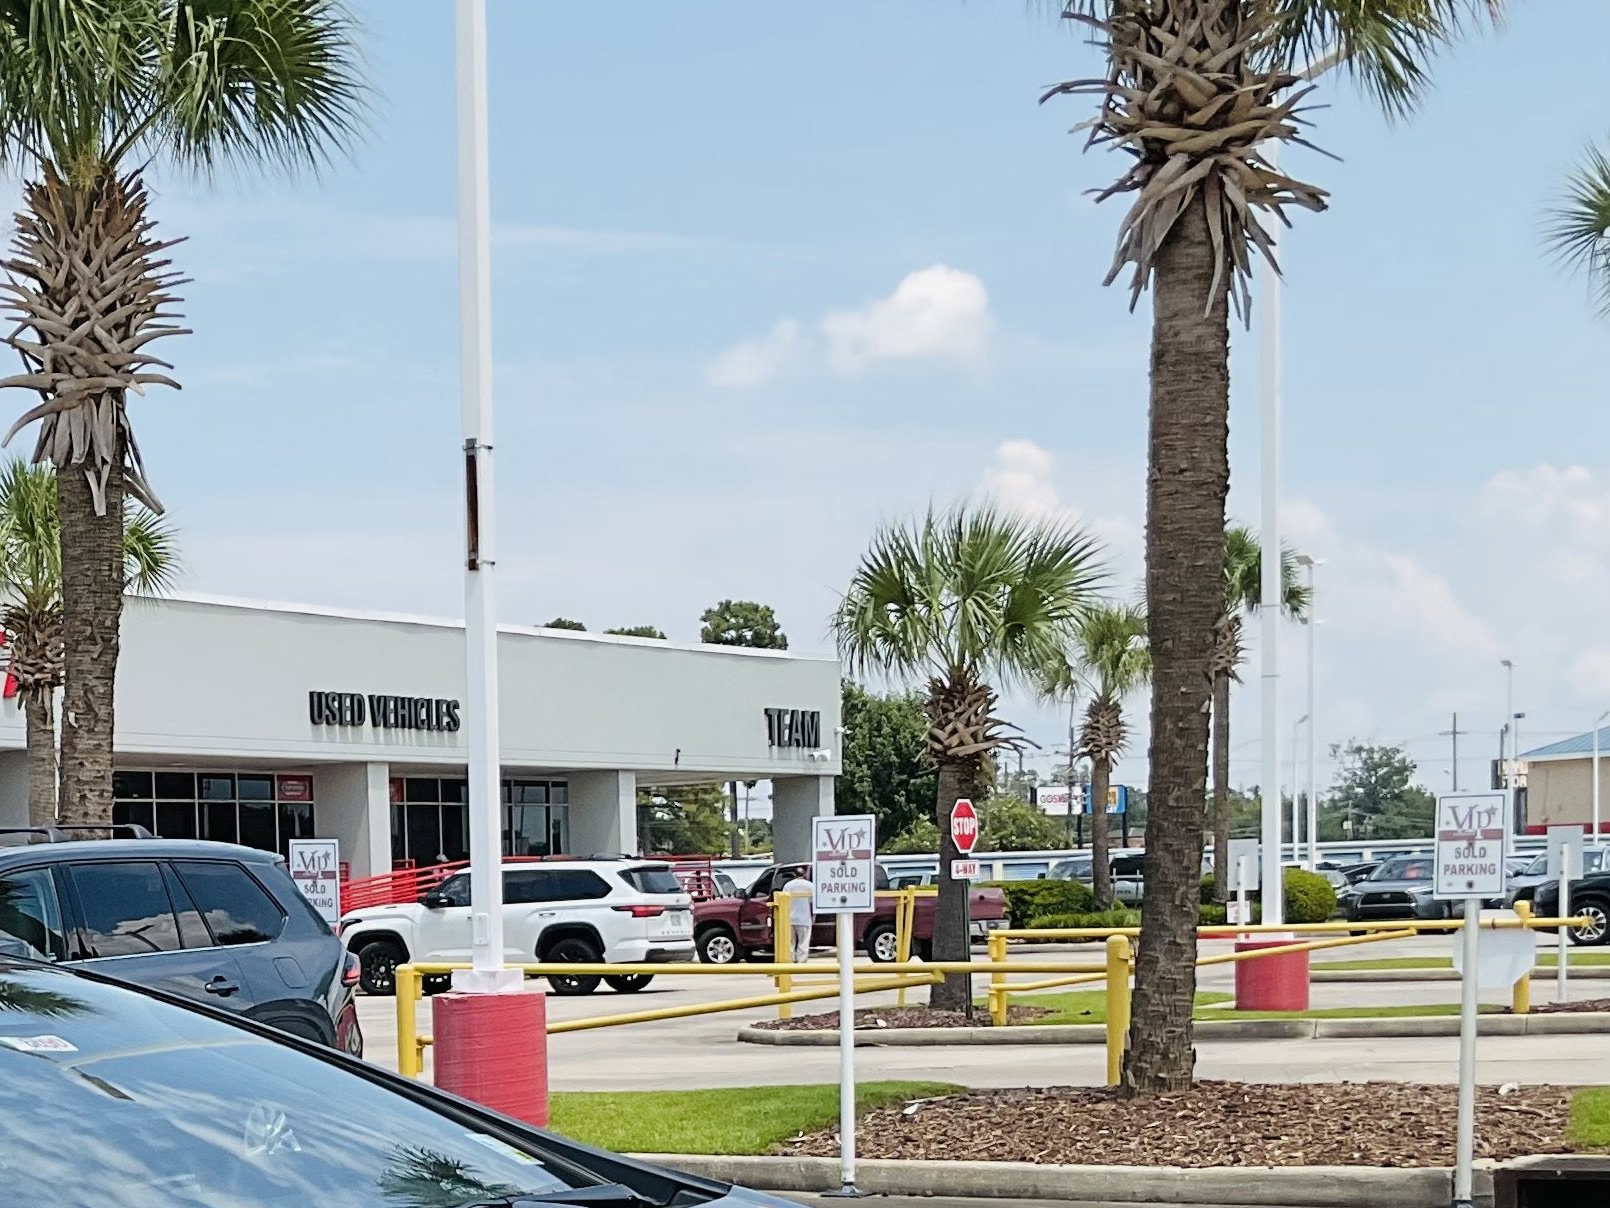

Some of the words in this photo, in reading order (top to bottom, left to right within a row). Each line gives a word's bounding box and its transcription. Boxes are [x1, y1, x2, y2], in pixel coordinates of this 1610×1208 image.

[309, 691, 366, 727] USED
[368, 694, 461, 732] VEHICLES
[763, 708, 820, 748] TEAM
[953, 817, 975, 836] STOP
[1454, 847, 1487, 859] SOLD
[830, 867, 858, 878] SOLD
[955, 864, 976, 875] 4-WAY
[1443, 863, 1496, 876] PARKING
[304, 884, 326, 894] SOLD
[821, 882, 866, 893] PARKING
